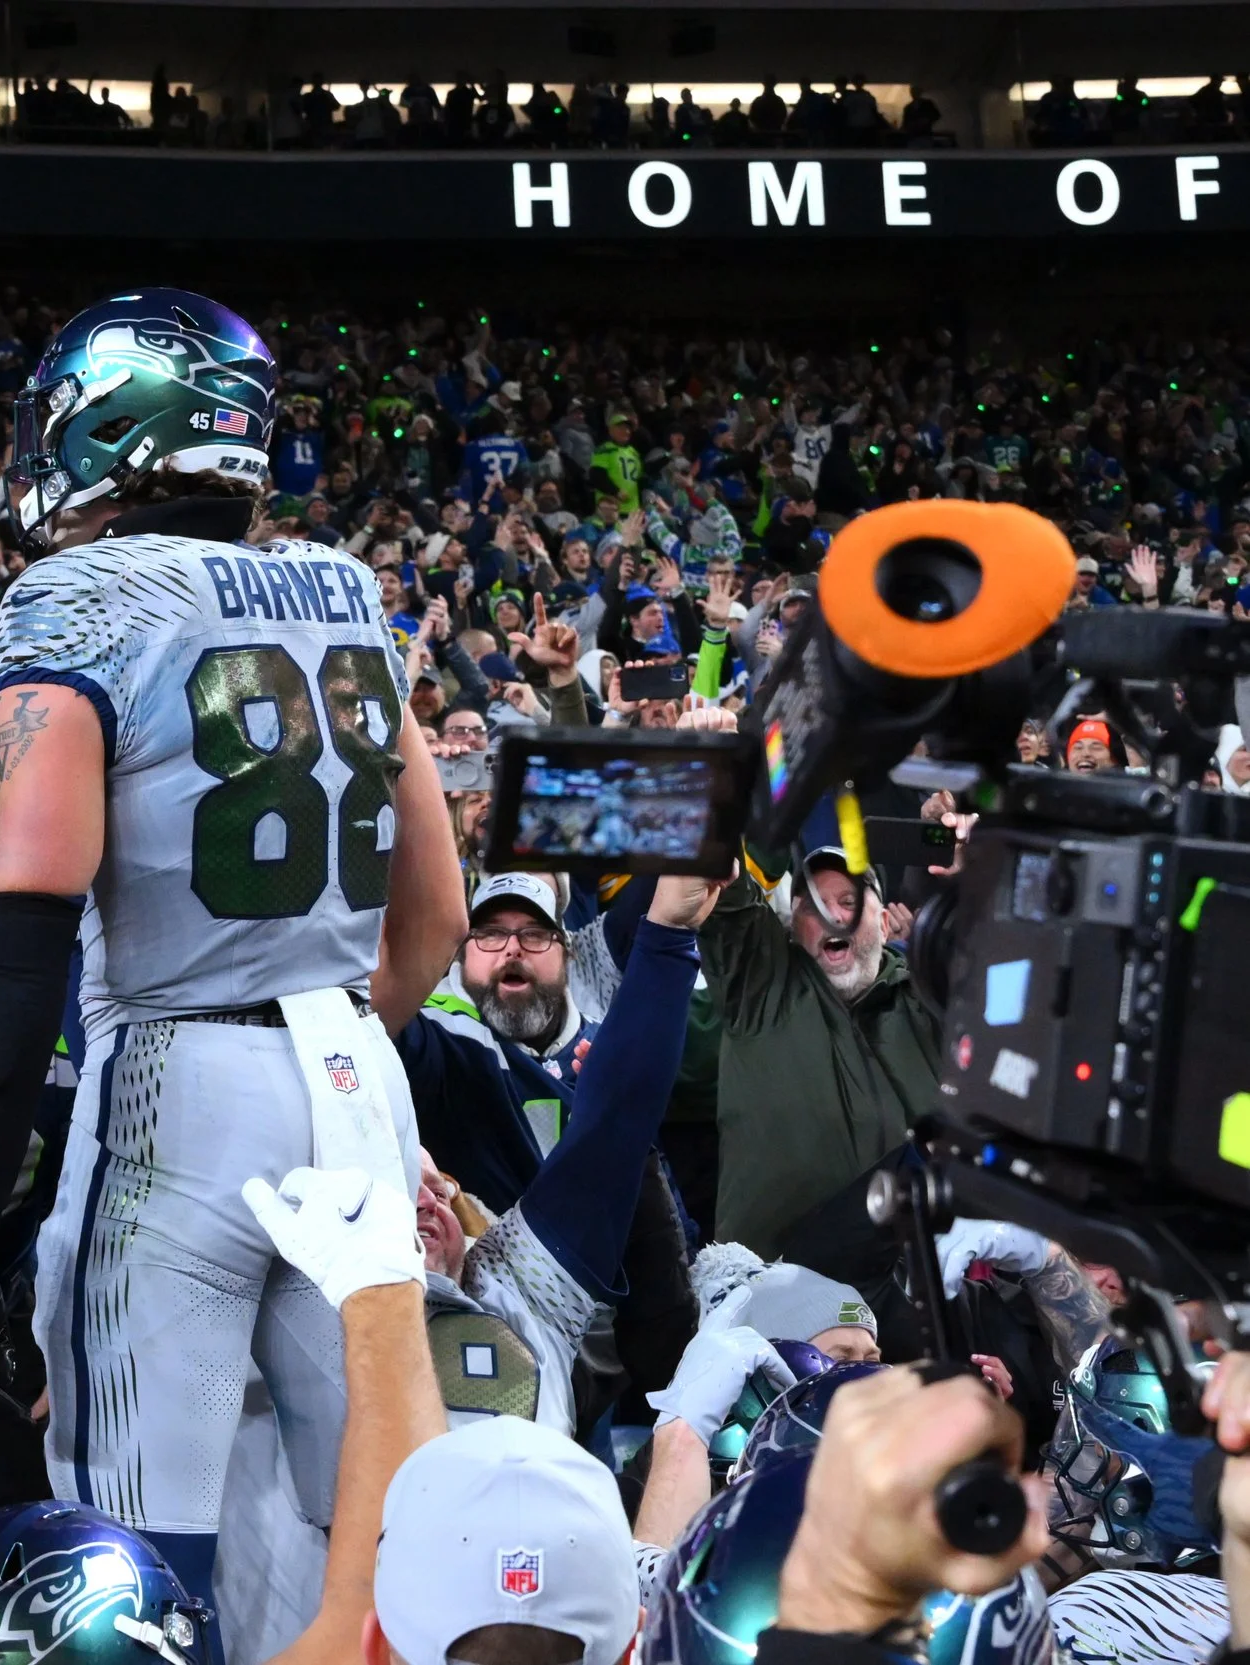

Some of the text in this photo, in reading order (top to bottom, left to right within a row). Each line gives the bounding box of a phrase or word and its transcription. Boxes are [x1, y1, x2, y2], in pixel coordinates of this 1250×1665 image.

[513, 155, 1221, 228] HOME OF
[189, 411, 211, 431] 45
[217, 456, 241, 471] 12
[241, 458, 261, 474] AS
[292, 439, 315, 466] 11
[479, 450, 520, 482] 37
[618, 455, 639, 482] 12
[200, 555, 371, 626] BARNER
[184, 643, 405, 920] 88
[195, 1012, 265, 1028] NIKE
[331, 1069, 356, 1089] NFL
[505, 1570, 538, 1594] NFL
